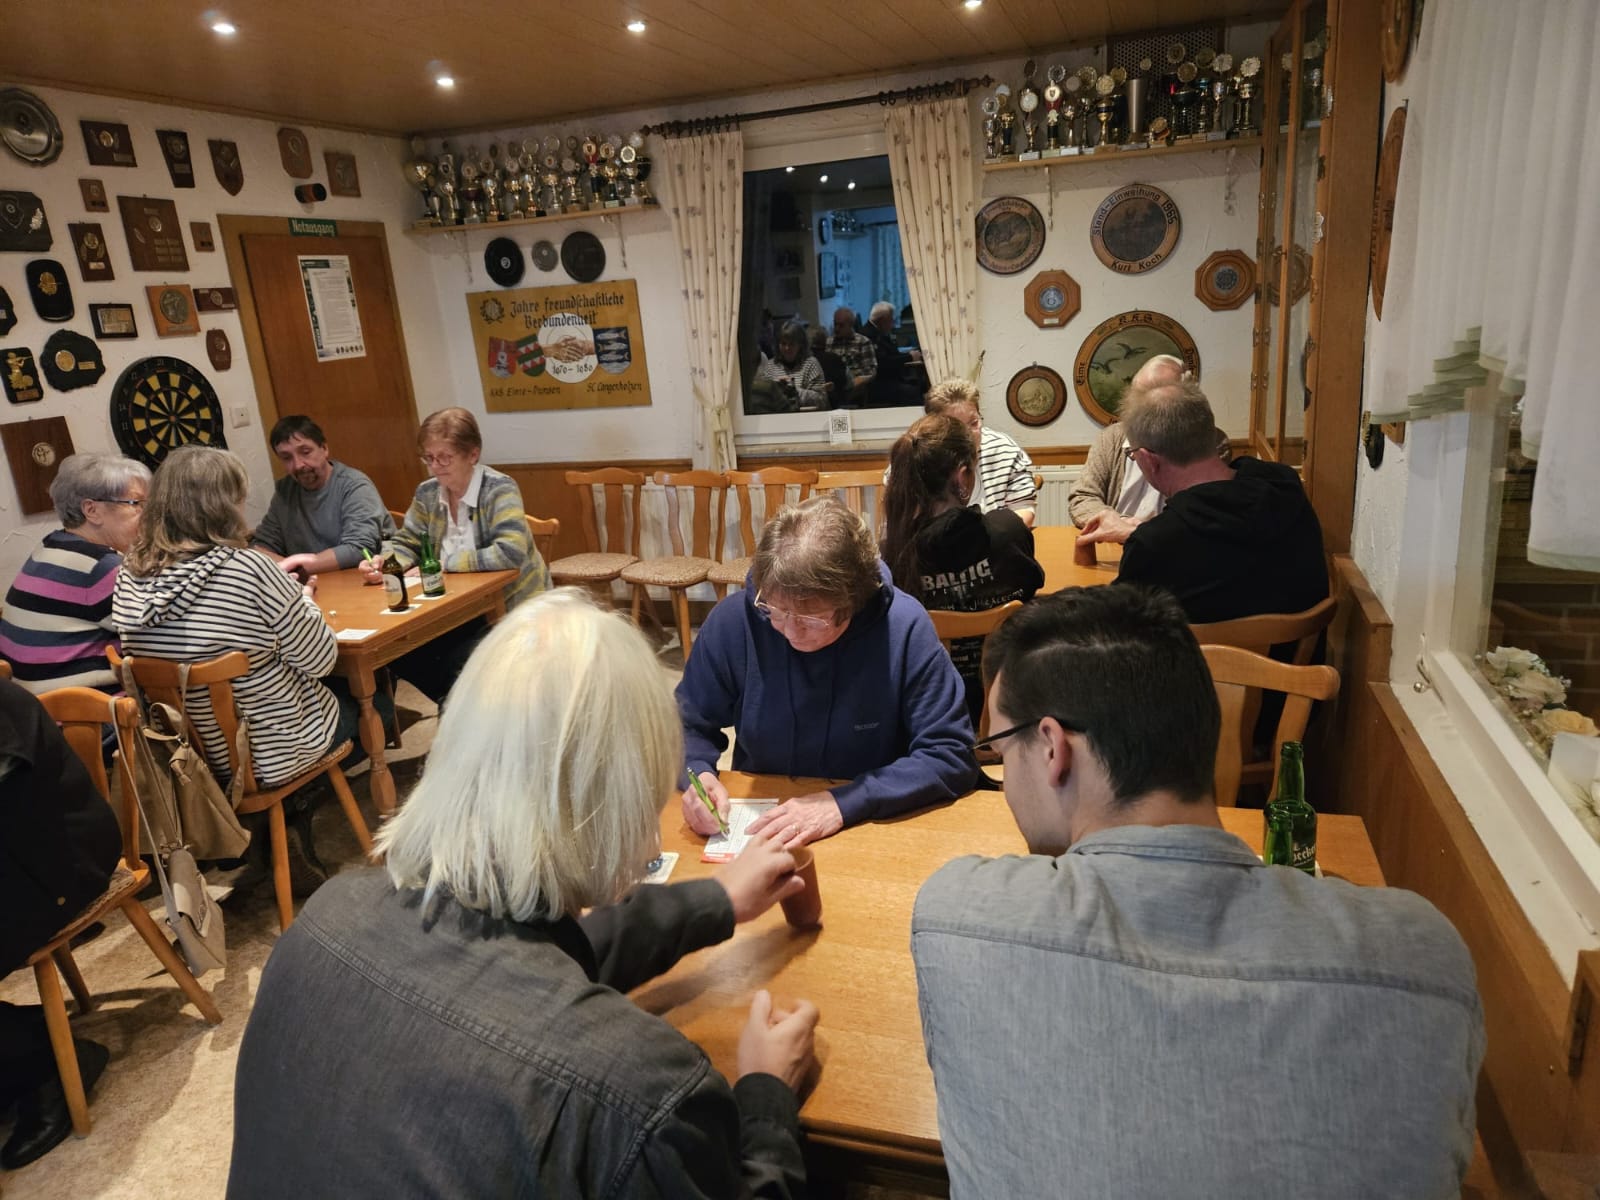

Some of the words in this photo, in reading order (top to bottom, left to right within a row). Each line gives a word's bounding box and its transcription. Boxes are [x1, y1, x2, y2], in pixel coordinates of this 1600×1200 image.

[291, 219, 336, 237] Notausgang
[1111, 260, 1132, 272] Kurt
[1139, 254, 1162, 270] Koch
[511, 300, 540, 318] Jahre
[525, 311, 597, 329] Verbundenheit
[920, 558, 992, 591] BALTIC
